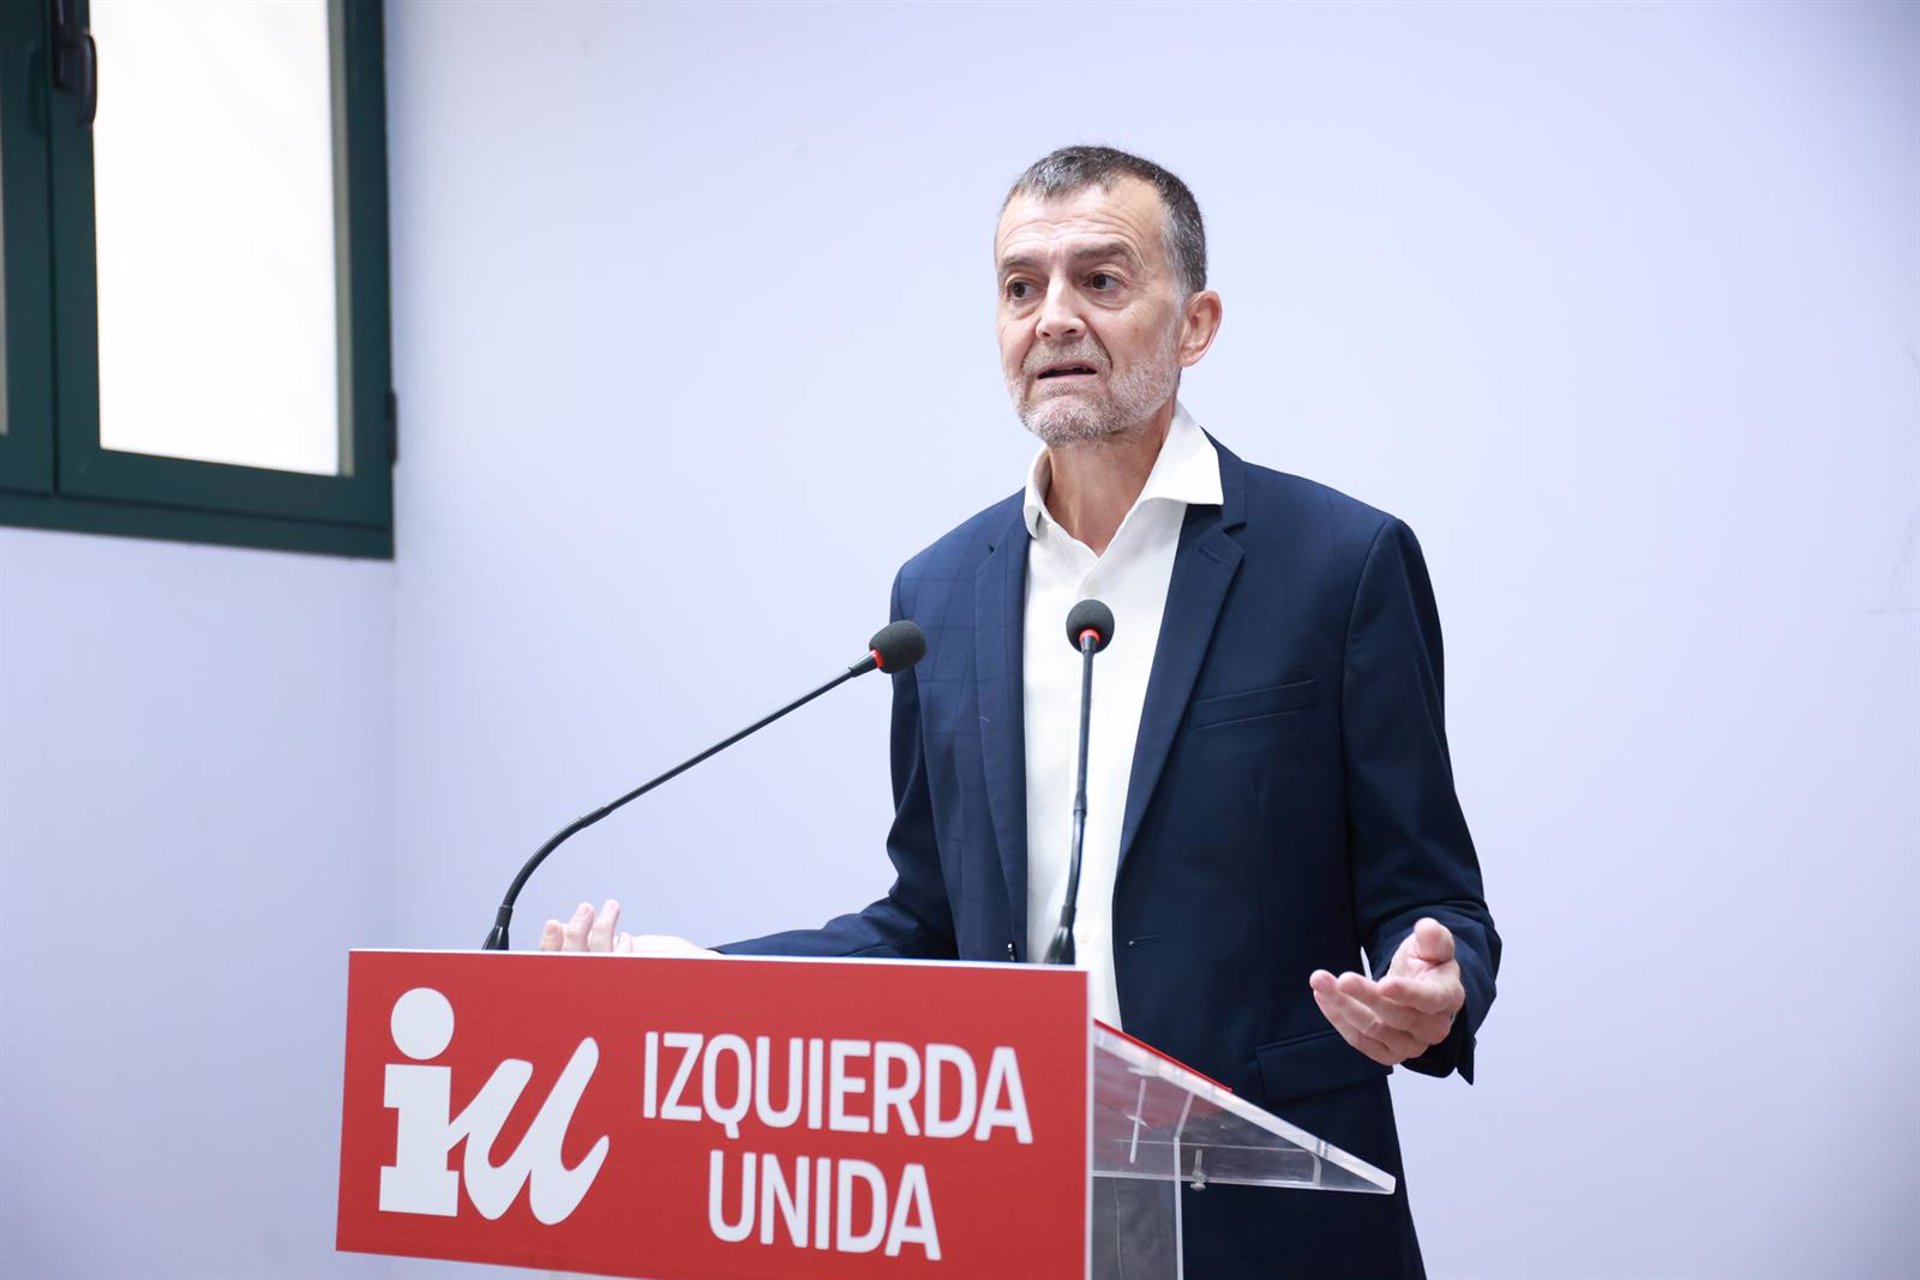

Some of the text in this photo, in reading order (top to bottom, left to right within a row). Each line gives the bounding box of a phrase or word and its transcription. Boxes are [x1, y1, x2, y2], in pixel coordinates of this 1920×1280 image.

[379, 987, 610, 1225] iu
[642, 1031, 1034, 1144] IZQUIERDA
[708, 1149, 941, 1261] UNIDA
